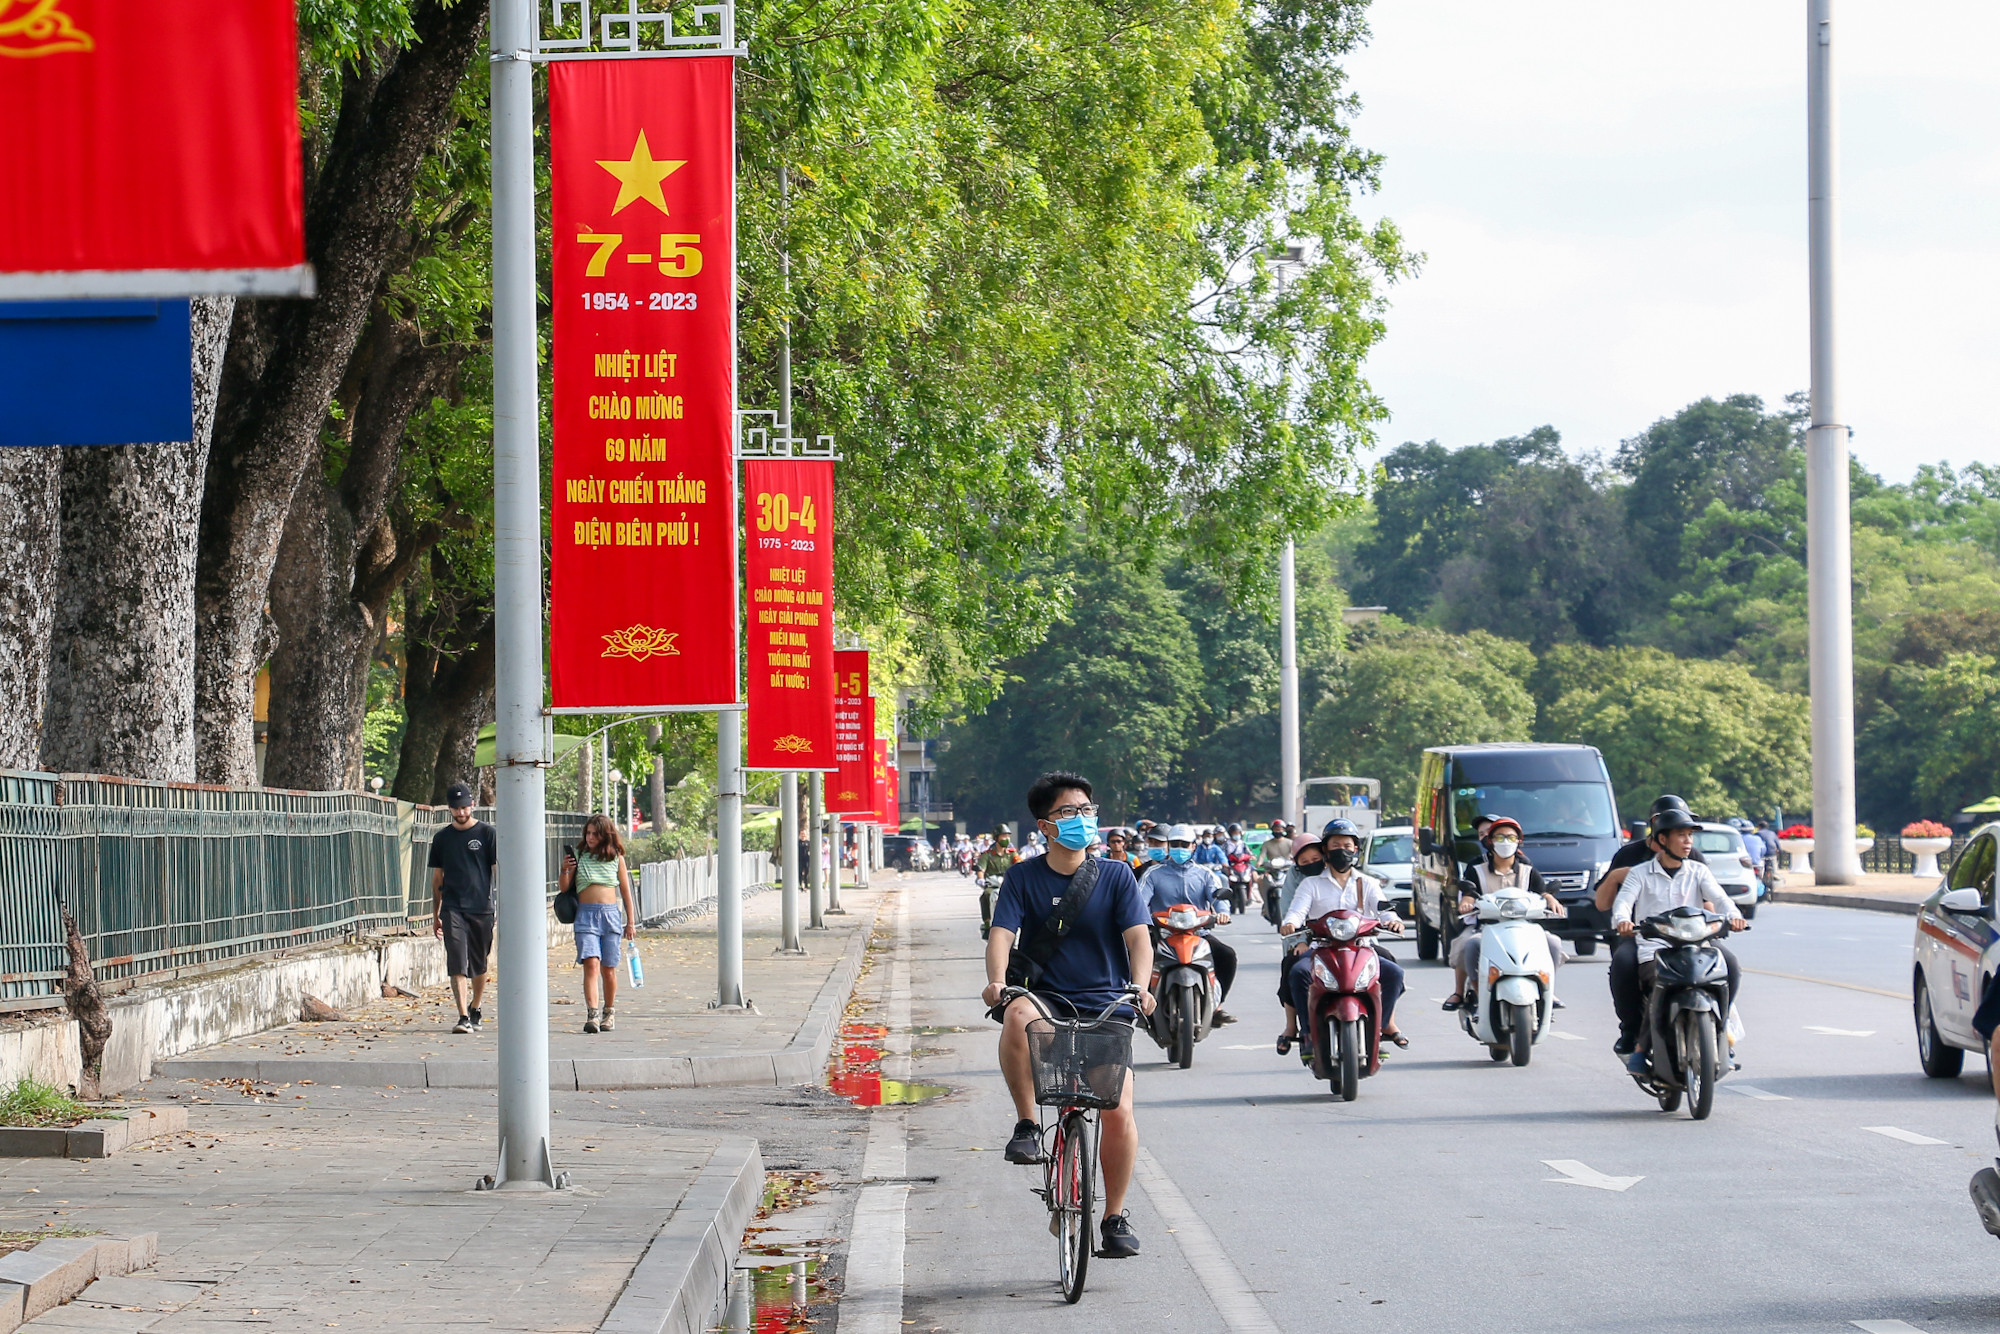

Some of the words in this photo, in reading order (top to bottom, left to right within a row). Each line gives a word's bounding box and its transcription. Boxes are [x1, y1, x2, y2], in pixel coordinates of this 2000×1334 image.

[577, 233, 703, 278] 7-5
[582, 293, 629, 310] 1954
[649, 293, 697, 310] 2023
[595, 349, 640, 383] NHIỆT
[645, 349, 677, 382] LIỆT
[589, 391, 631, 420] CHÀO
[636, 390, 683, 419] MỪNG
[606, 438, 625, 461] 69
[630, 433, 666, 461] NĂM
[567, 475, 605, 503] NGÀY
[610, 472, 653, 503] CHIẾN
[657, 472, 705, 503] THẮNG
[756, 492, 817, 534] 30-4
[574, 517, 611, 550] ĐIỆN
[616, 518, 652, 546] BIÊN
[657, 512, 688, 545] PHỦ
[694, 522, 698, 545] !
[758, 537, 782, 549] 1975
[790, 538, 815, 552] 2023
[770, 566, 790, 584] NHIỆT
[792, 567, 806, 585] LIỆT
[755, 587, 772, 602] CHÀO
[774, 587, 795, 603] MỪNG
[796, 591, 805, 604] 48
[807, 590, 823, 605] NĂM
[759, 608, 777, 623] NGÀY
[779, 606, 793, 624] GIẢI
[795, 610, 819, 626] PHÓNG
[789, 633, 808, 648] NAM,
[768, 649, 791, 666] THỐNG
[792, 650, 811, 668] NHẤT
[785, 672, 805, 689] NƯỚC
[807, 676, 810, 689] !
